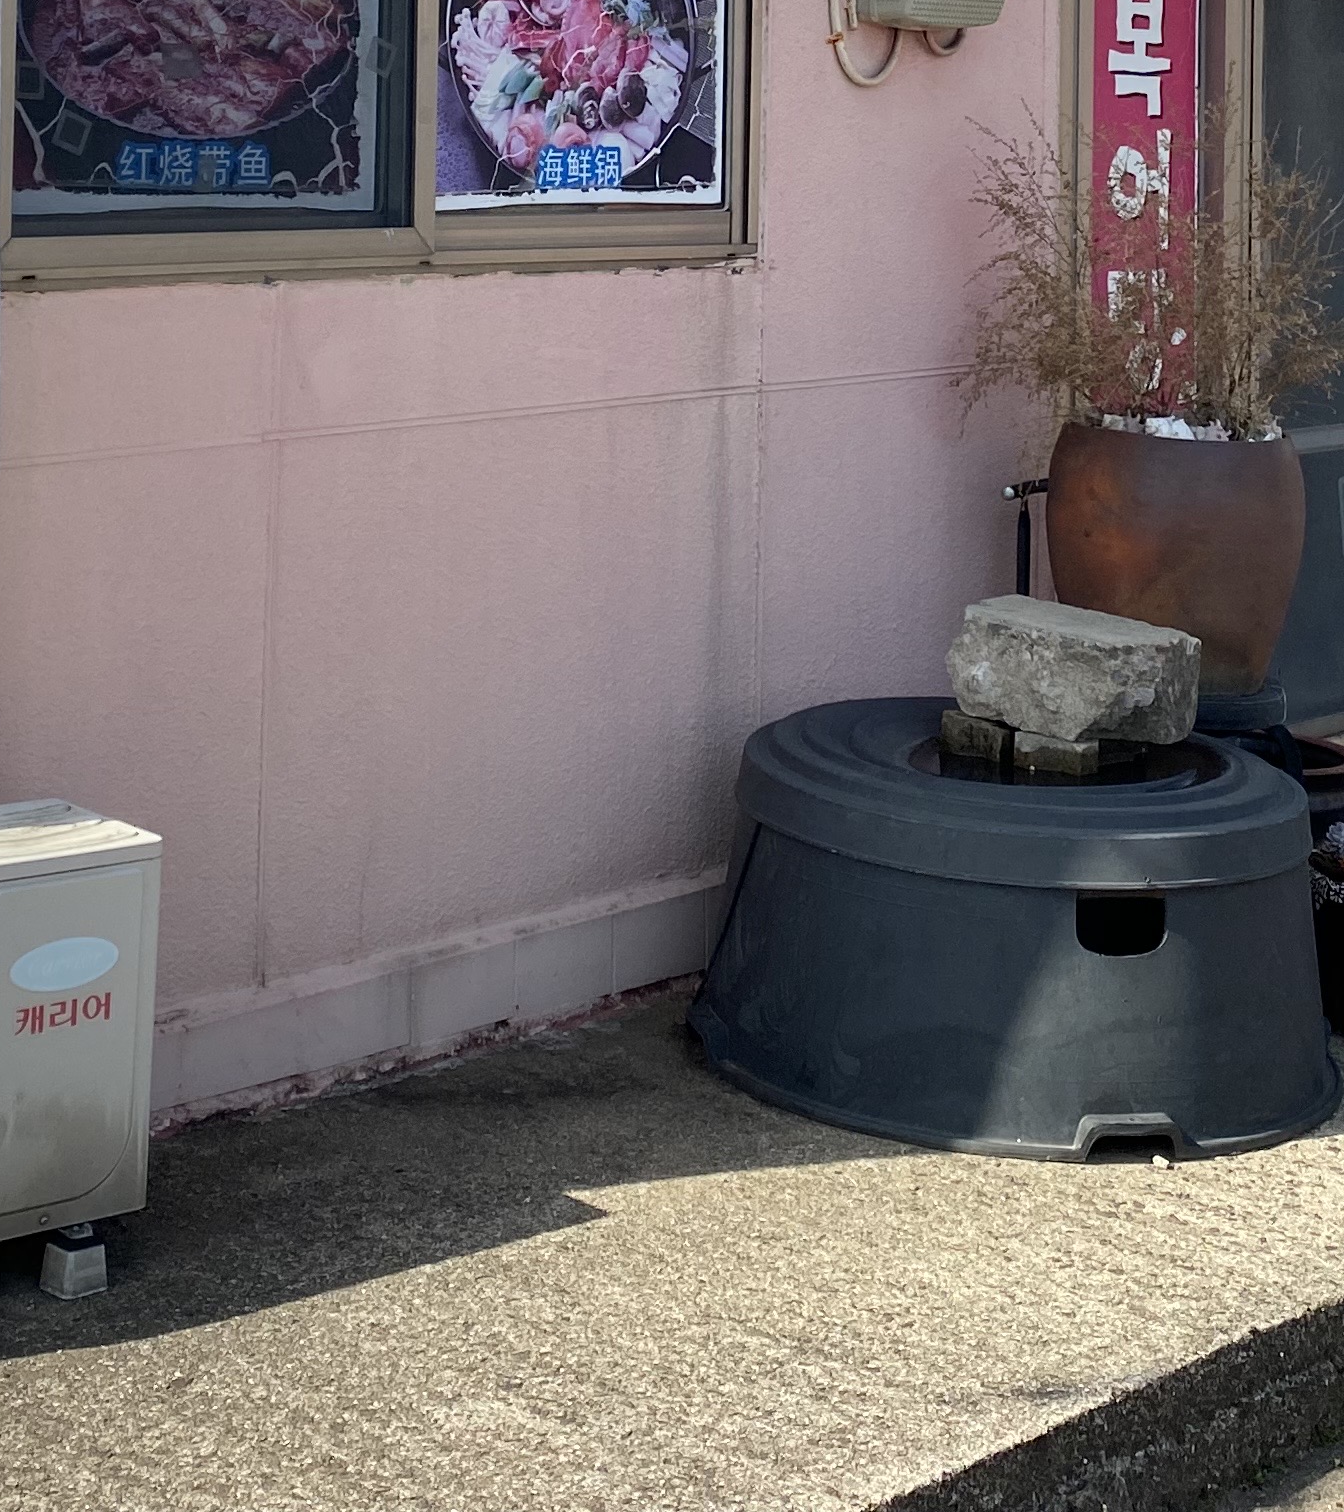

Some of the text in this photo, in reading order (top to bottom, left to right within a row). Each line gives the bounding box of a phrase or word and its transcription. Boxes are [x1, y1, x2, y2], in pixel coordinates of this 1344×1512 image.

[537, 148, 620, 188] 海鲜锅
[15, 992, 111, 1036] 캐리어
